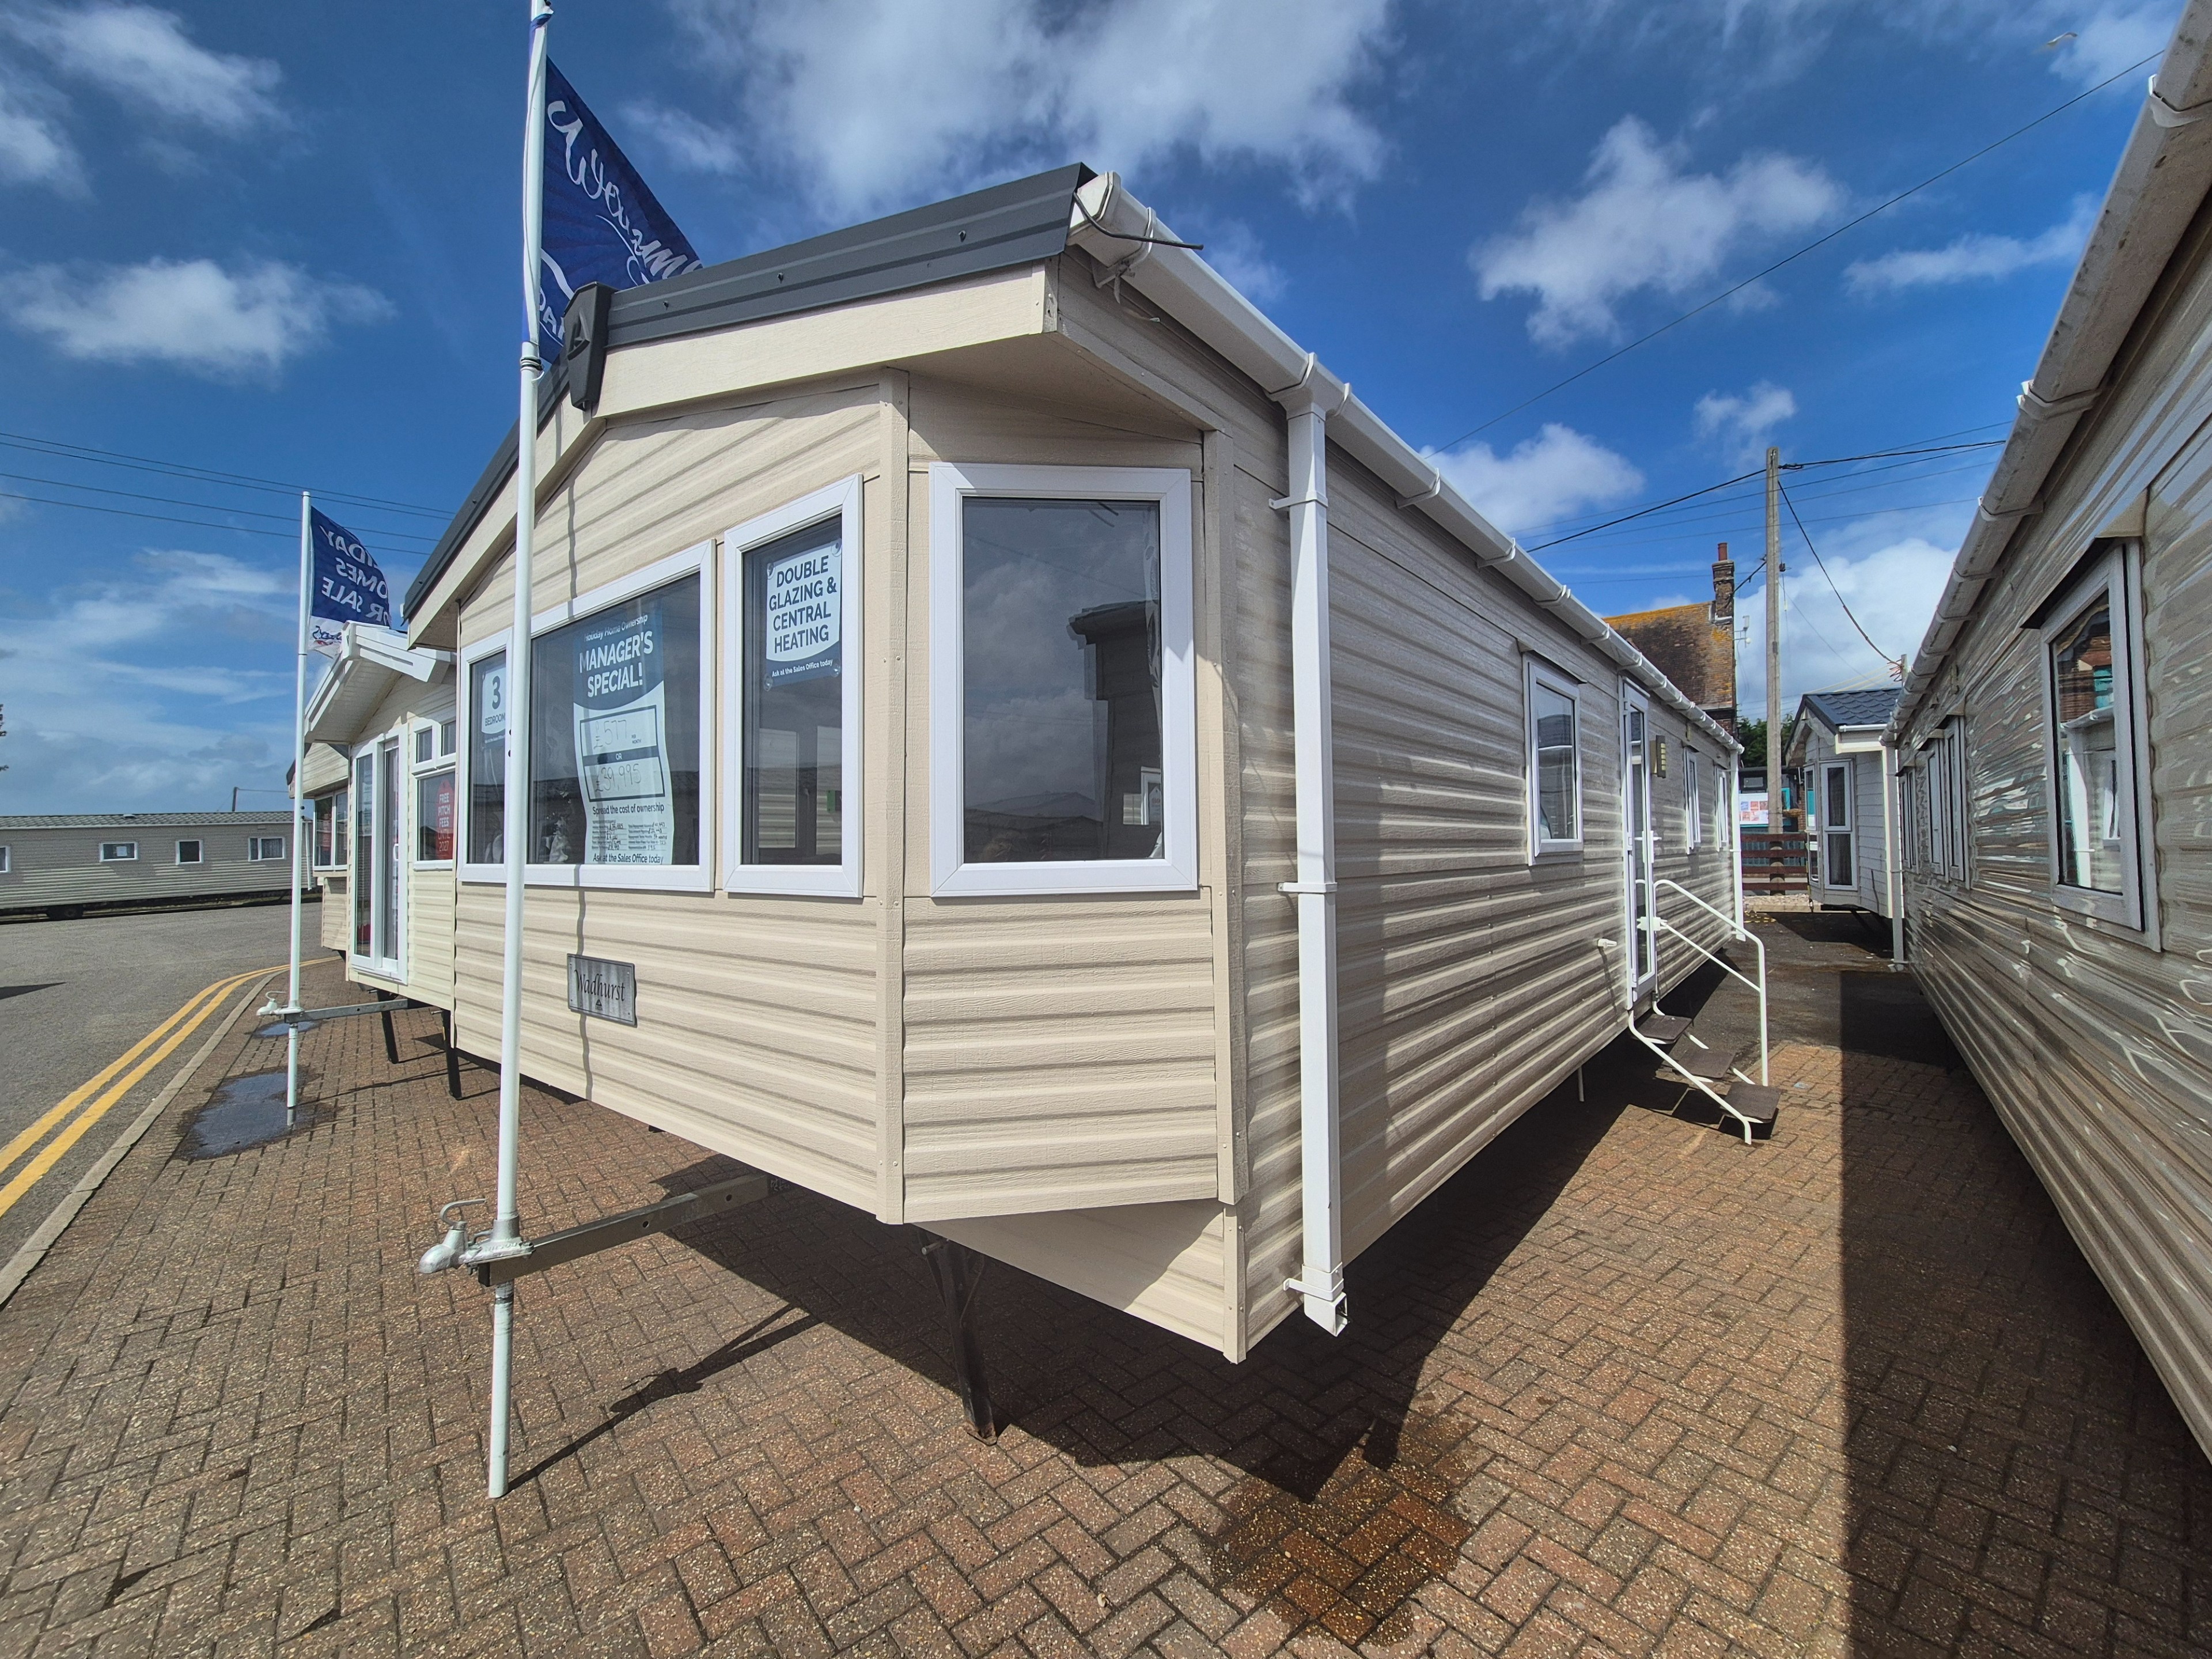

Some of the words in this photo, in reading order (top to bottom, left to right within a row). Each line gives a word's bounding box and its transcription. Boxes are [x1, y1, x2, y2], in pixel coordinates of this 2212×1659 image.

[777, 555, 829, 588] DOUBLE
[769, 579, 823, 611] GLAZING
[826, 576, 837, 593] &
[604, 625, 620, 637] Home
[621, 615, 648, 631] Ownership
[773, 601, 831, 631] CENTRAL
[579, 630, 654, 673] MANAGER'S
[774, 624, 829, 654] HEATING
[587, 662, 643, 698] SPECIAL!
[772, 669, 780, 677] Ask
[793, 665, 805, 673] Sales
[806, 662, 819, 670] Office
[820, 658, 833, 667] today
[492, 675, 501, 710] 3
[595, 763, 642, 793] £39,995
[438, 804, 450, 816] PITCH
[440, 793, 449, 805] FREE
[592, 805, 609, 817] Spread
[610, 805, 618, 814] the
[619, 805, 630, 814] cost
[630, 804, 636, 813] of
[637, 802, 665, 814] ownership
[440, 817, 449, 828] FEES
[593, 853, 601, 862] Ask
[603, 854, 608, 862] at
[608, 853, 617, 862] the
[618, 853, 631, 862] Sales
[632, 853, 647, 863] Office
[649, 854, 664, 865] today
[574, 969, 625, 1002] Wadhurst
